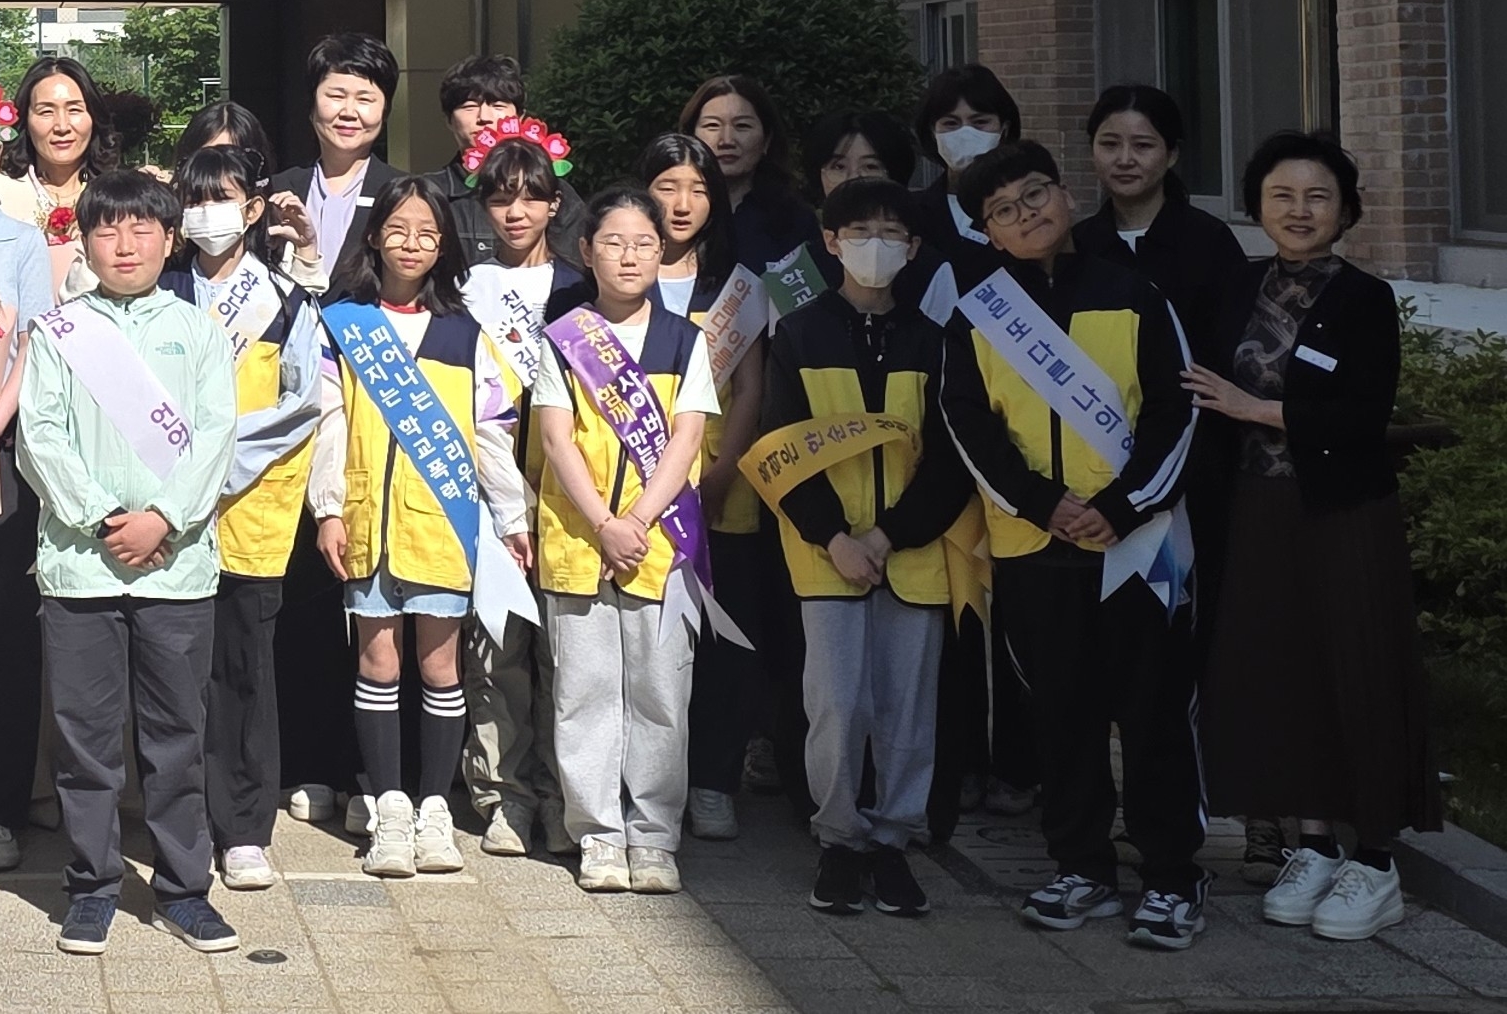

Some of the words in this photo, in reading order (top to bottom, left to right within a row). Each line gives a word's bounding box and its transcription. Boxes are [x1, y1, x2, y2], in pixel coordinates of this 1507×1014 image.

[218, 268, 260, 328] 장난이
[780, 268, 819, 308] 학교
[369, 325, 434, 412] 피어나는
[973, 283, 1012, 320] 말은
[1006, 317, 1033, 344] 또
[1027, 339, 1076, 387] 다른
[1071, 384, 1123, 434] 나의
[344, 323, 402, 408] 사라지는
[397, 414, 462, 500] 학교폭력
[596, 383, 638, 425] 함께
